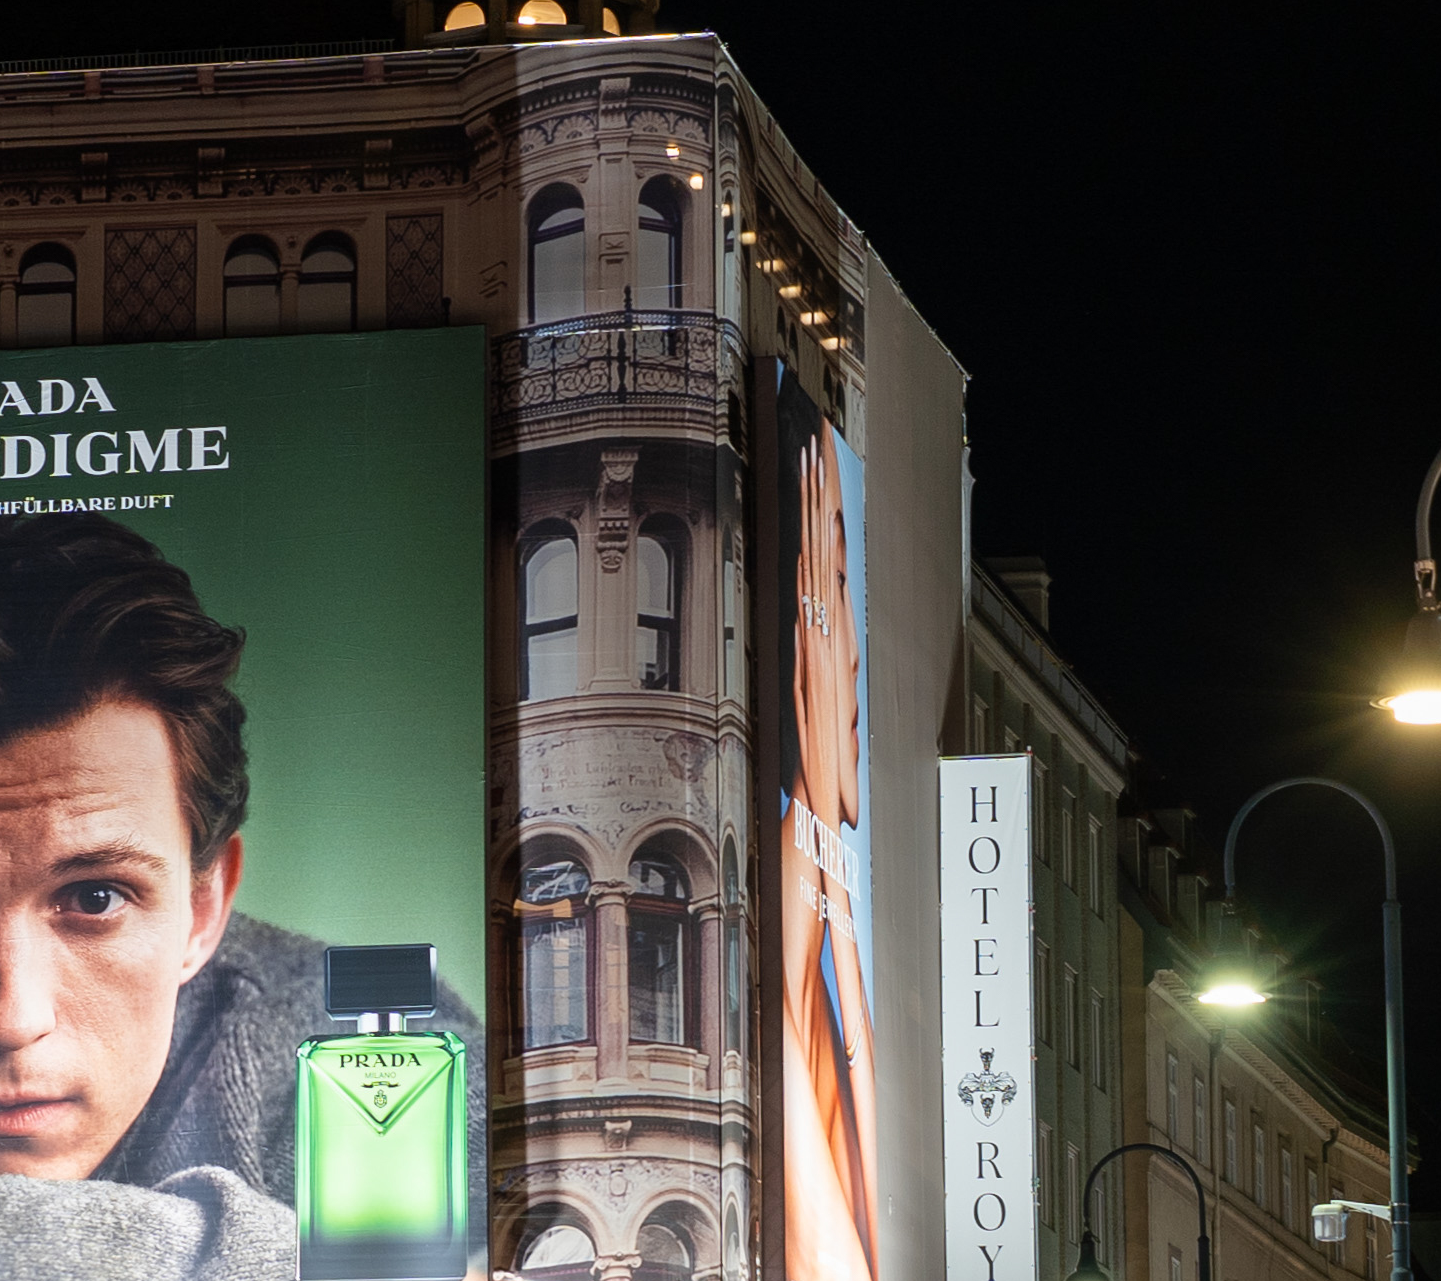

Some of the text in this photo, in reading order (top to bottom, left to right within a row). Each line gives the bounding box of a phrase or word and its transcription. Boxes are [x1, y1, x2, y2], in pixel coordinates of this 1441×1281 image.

[120, 494, 174, 510] DUFT
[794, 798, 861, 902] BUCHERER
[799, 875, 817, 911] FINE
[968, 786, 1001, 1029] HOTEL
[340, 1052, 422, 1068] PRADA
